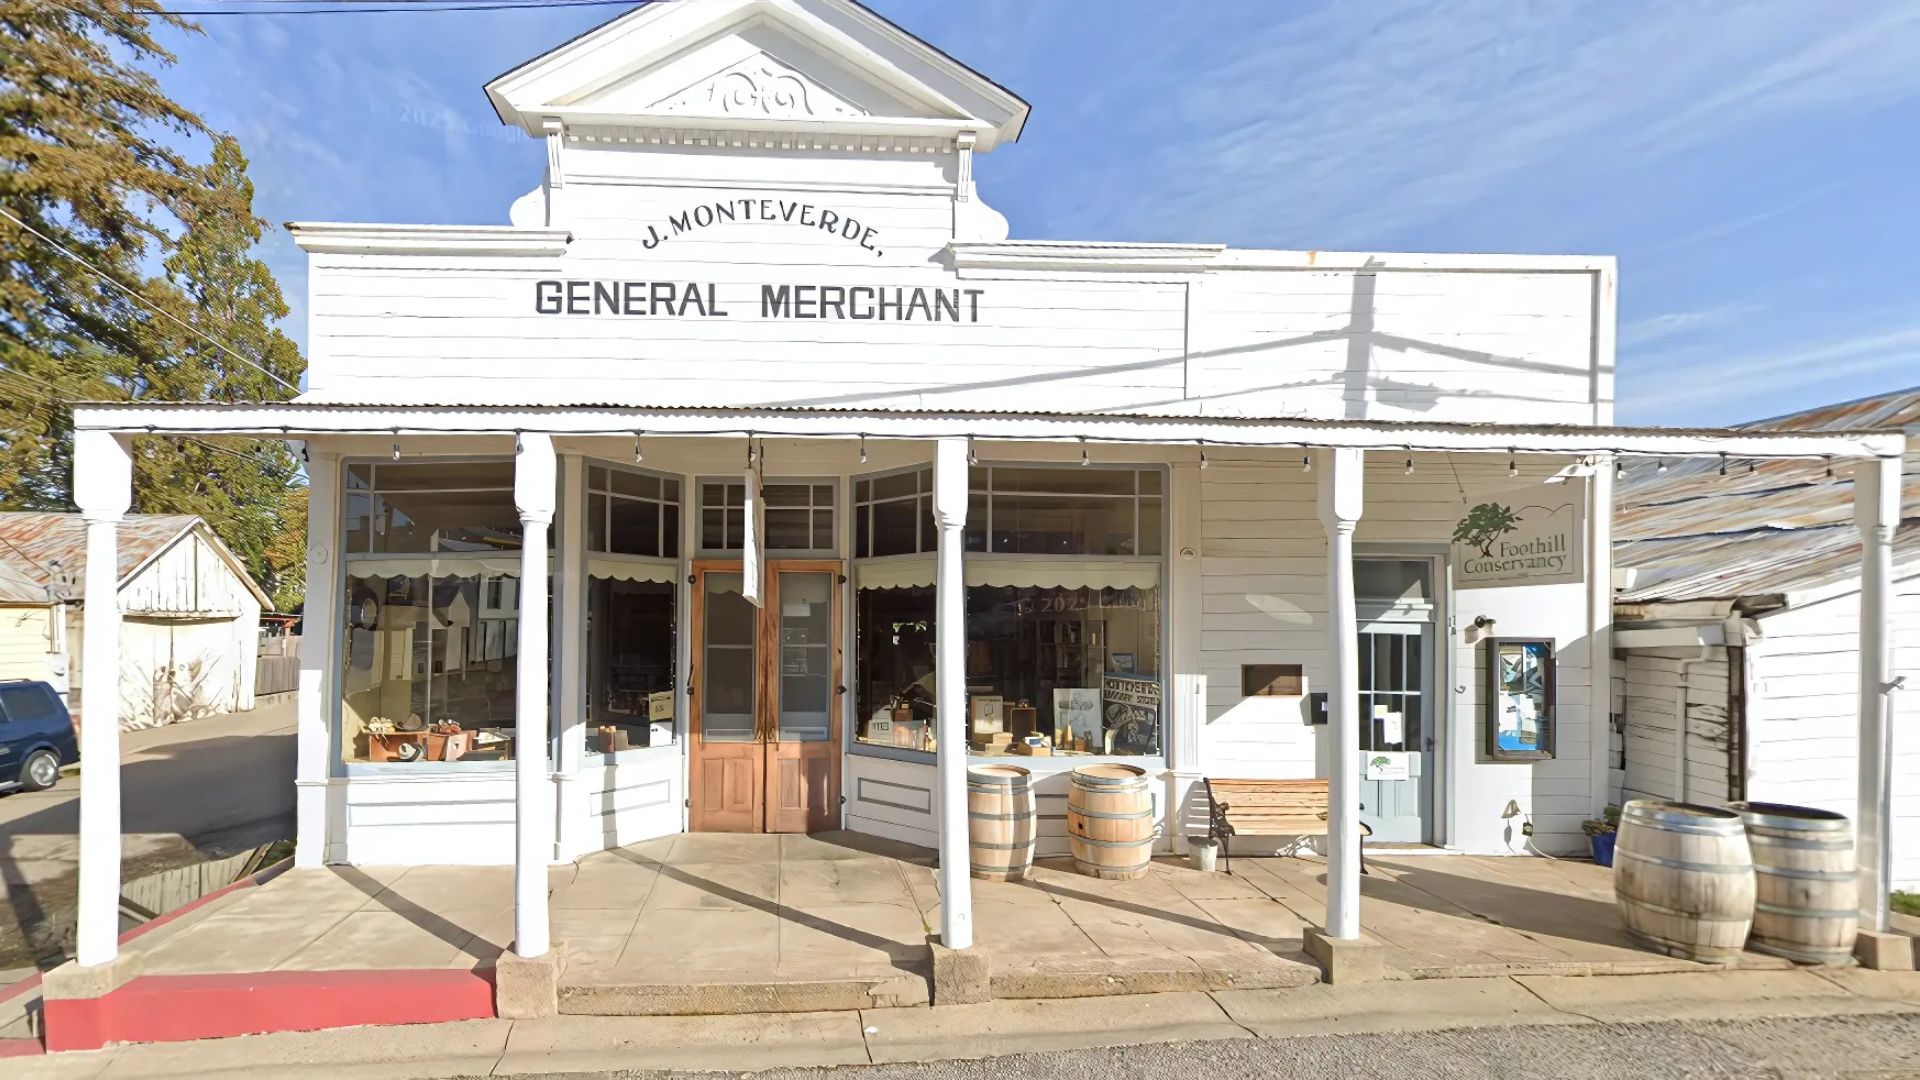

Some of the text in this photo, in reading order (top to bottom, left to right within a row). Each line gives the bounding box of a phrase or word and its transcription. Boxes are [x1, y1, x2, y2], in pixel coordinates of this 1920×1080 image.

[669, 199, 883, 257] MONTEVERDE,
[536, 280, 985, 323] GENERAL MERCHANT
[1500, 534, 1565, 557] Foothill
[1464, 555, 1566, 574] Conservancy
